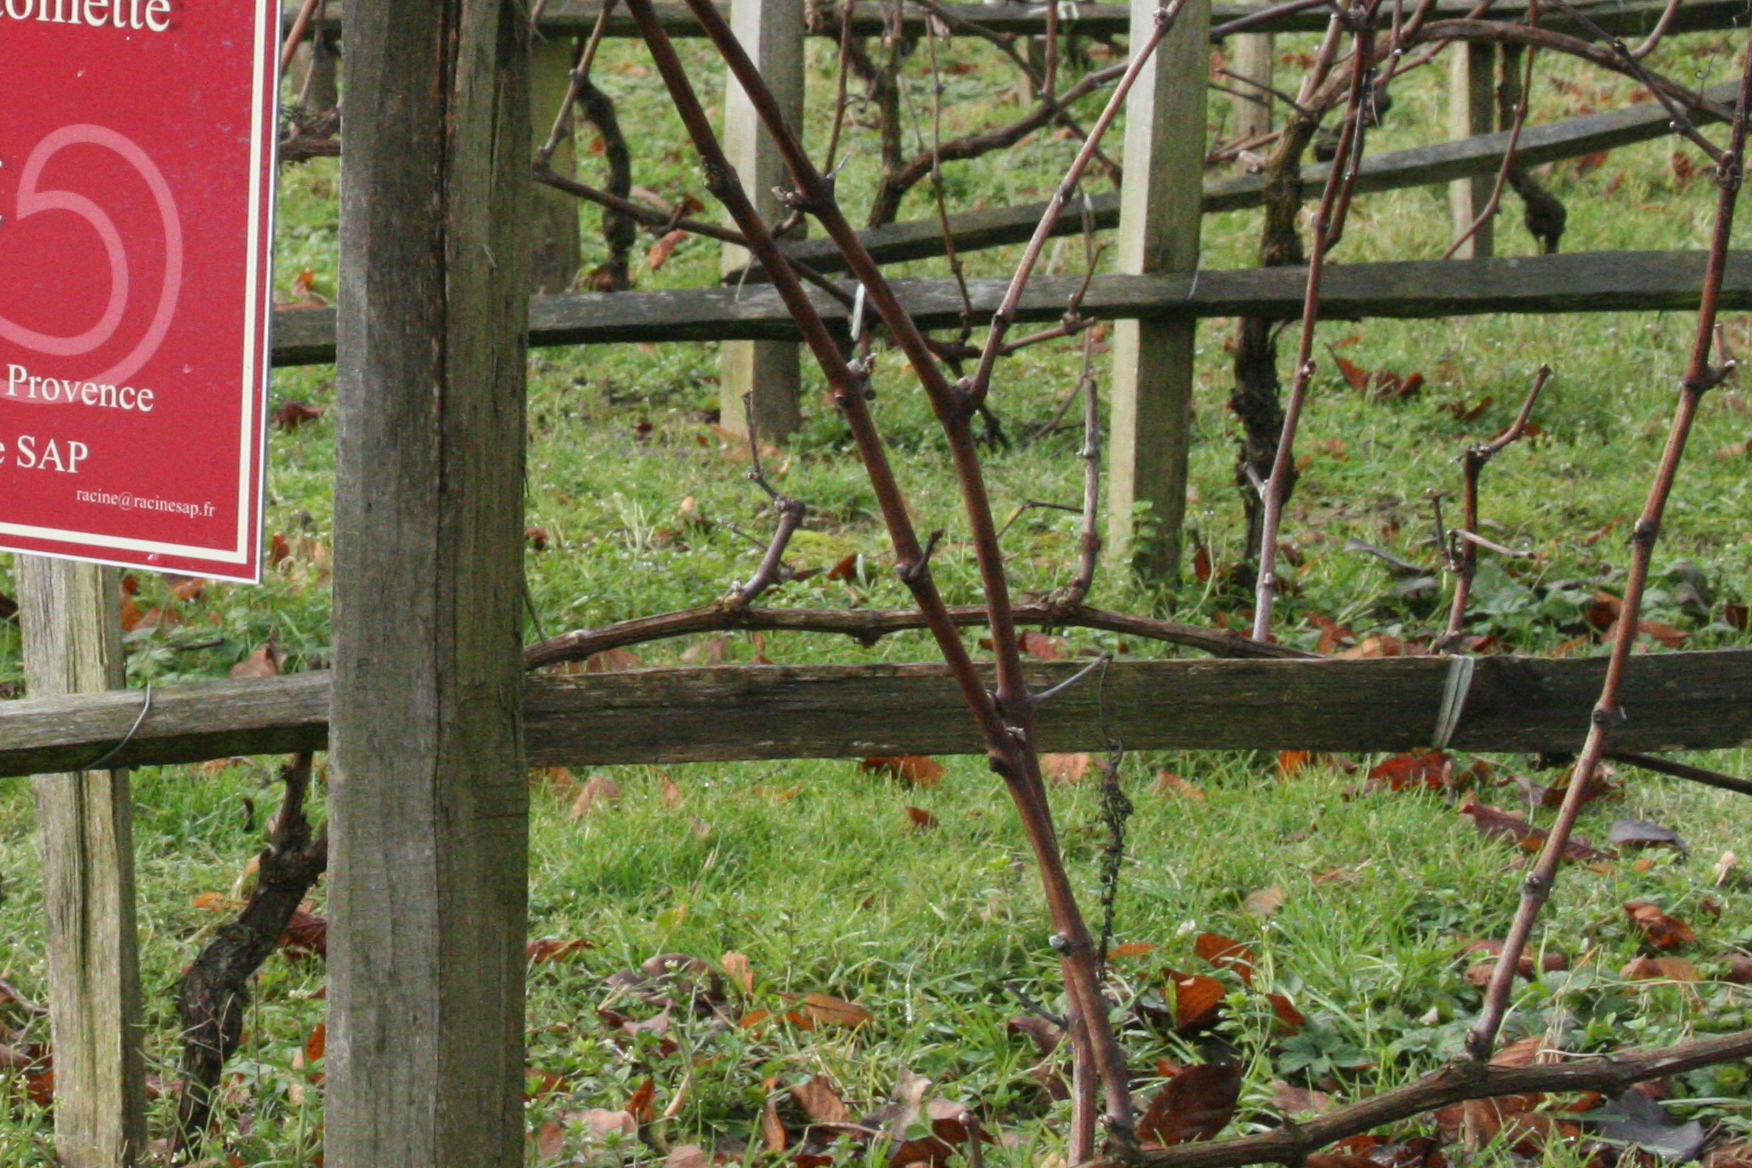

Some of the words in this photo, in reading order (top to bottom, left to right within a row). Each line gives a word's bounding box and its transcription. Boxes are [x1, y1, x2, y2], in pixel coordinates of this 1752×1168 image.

[6, 364, 154, 412] Provence
[16, 434, 89, 474] SAP
[76, 488, 216, 519] racine@racinesap.fr
